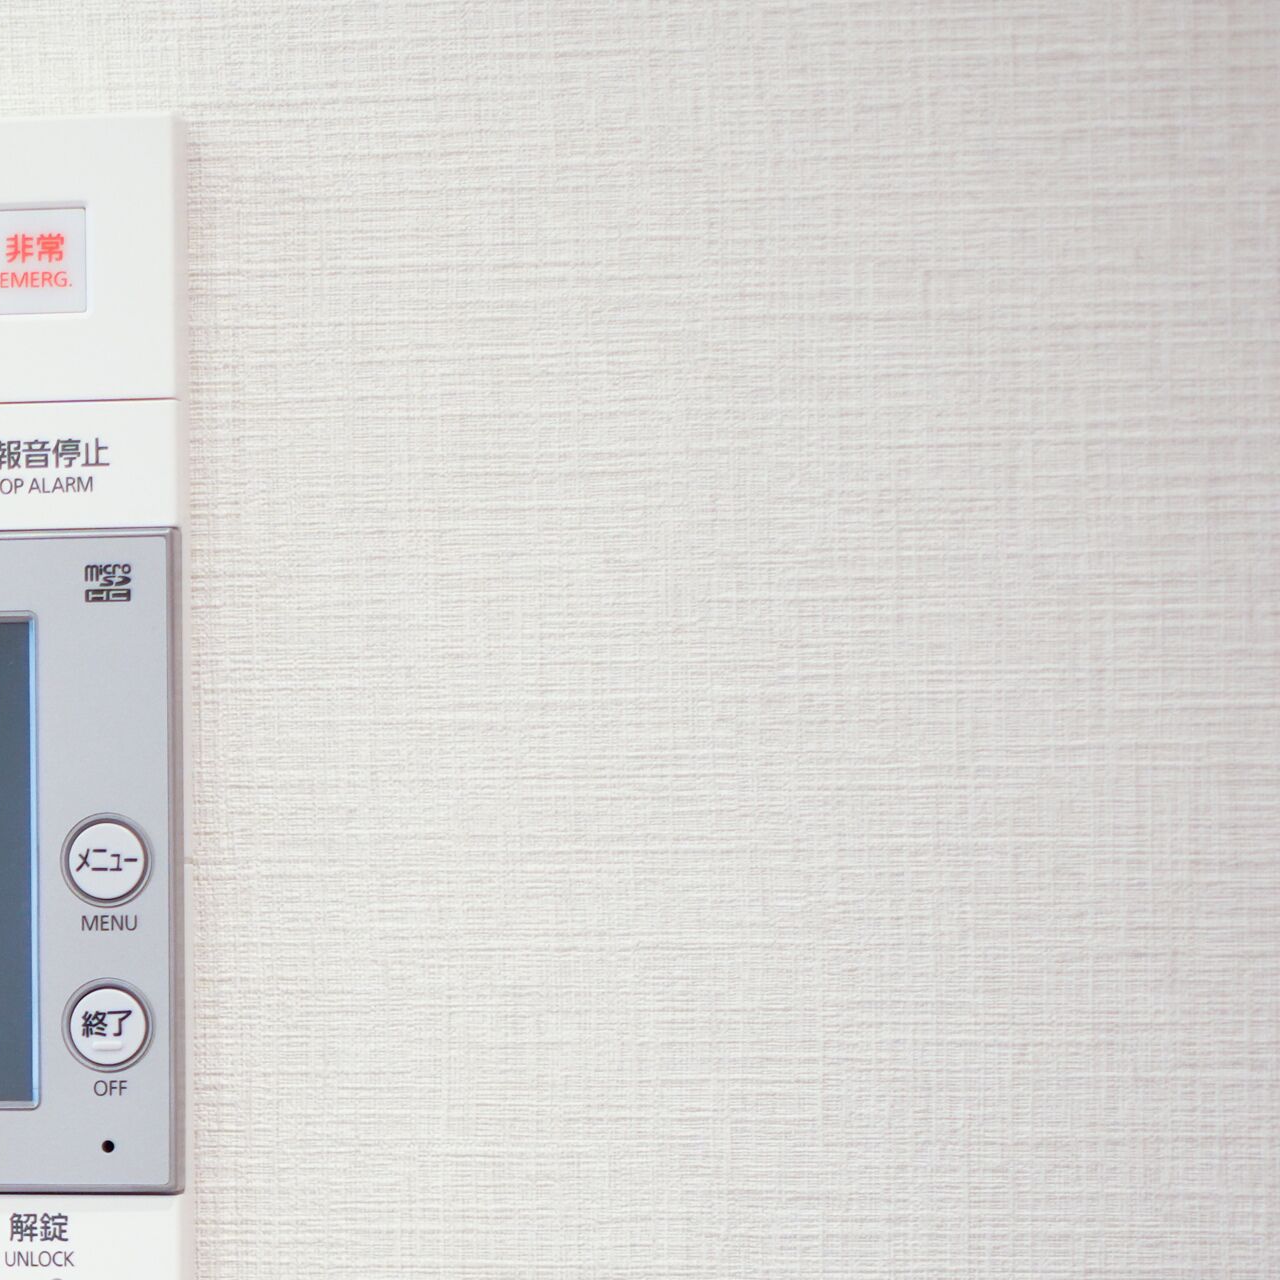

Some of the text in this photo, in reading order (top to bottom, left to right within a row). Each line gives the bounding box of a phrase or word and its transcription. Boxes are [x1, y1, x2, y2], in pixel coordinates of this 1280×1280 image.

[5, 233, 65, 264] 非常
[0, 271, 73, 289] EMERG.
[28, 476, 94, 494] ALARM
[84, 563, 132, 582] micro
[76, 848, 138, 872] メニュー
[81, 914, 138, 932] MENU
[82, 1010, 132, 1038] 終了
[93, 1080, 128, 1097] OFF
[9, 1212, 70, 1243] 解錠
[4, 1251, 75, 1268] UNLOCK
